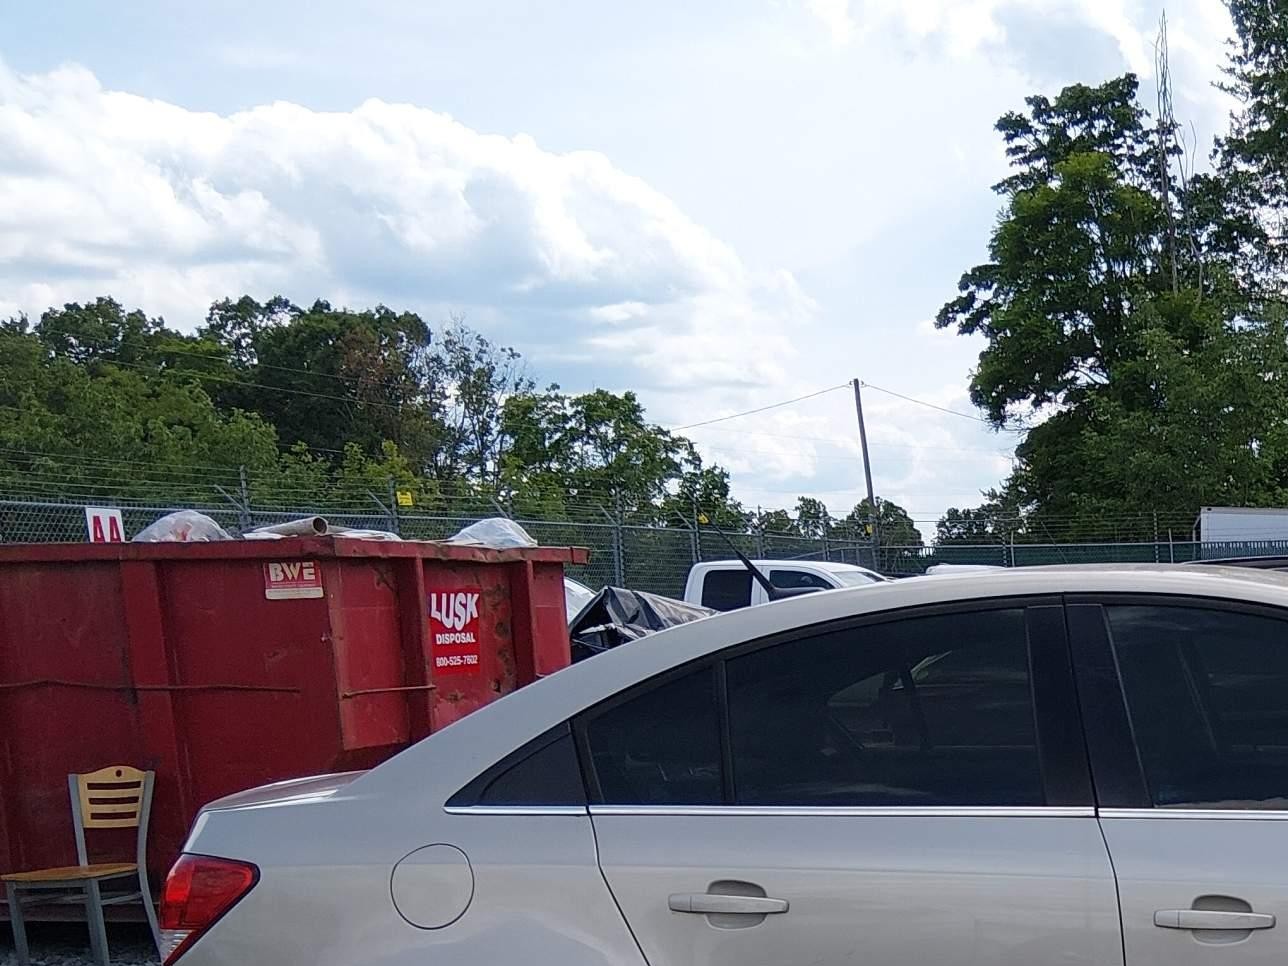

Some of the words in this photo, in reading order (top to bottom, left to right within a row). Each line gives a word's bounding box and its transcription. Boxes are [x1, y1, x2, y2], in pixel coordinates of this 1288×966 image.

[92, 515, 122, 543] AA
[268, 561, 316, 582] BWE
[430, 592, 480, 632] LUSK
[435, 632, 477, 645] DISPOSAL
